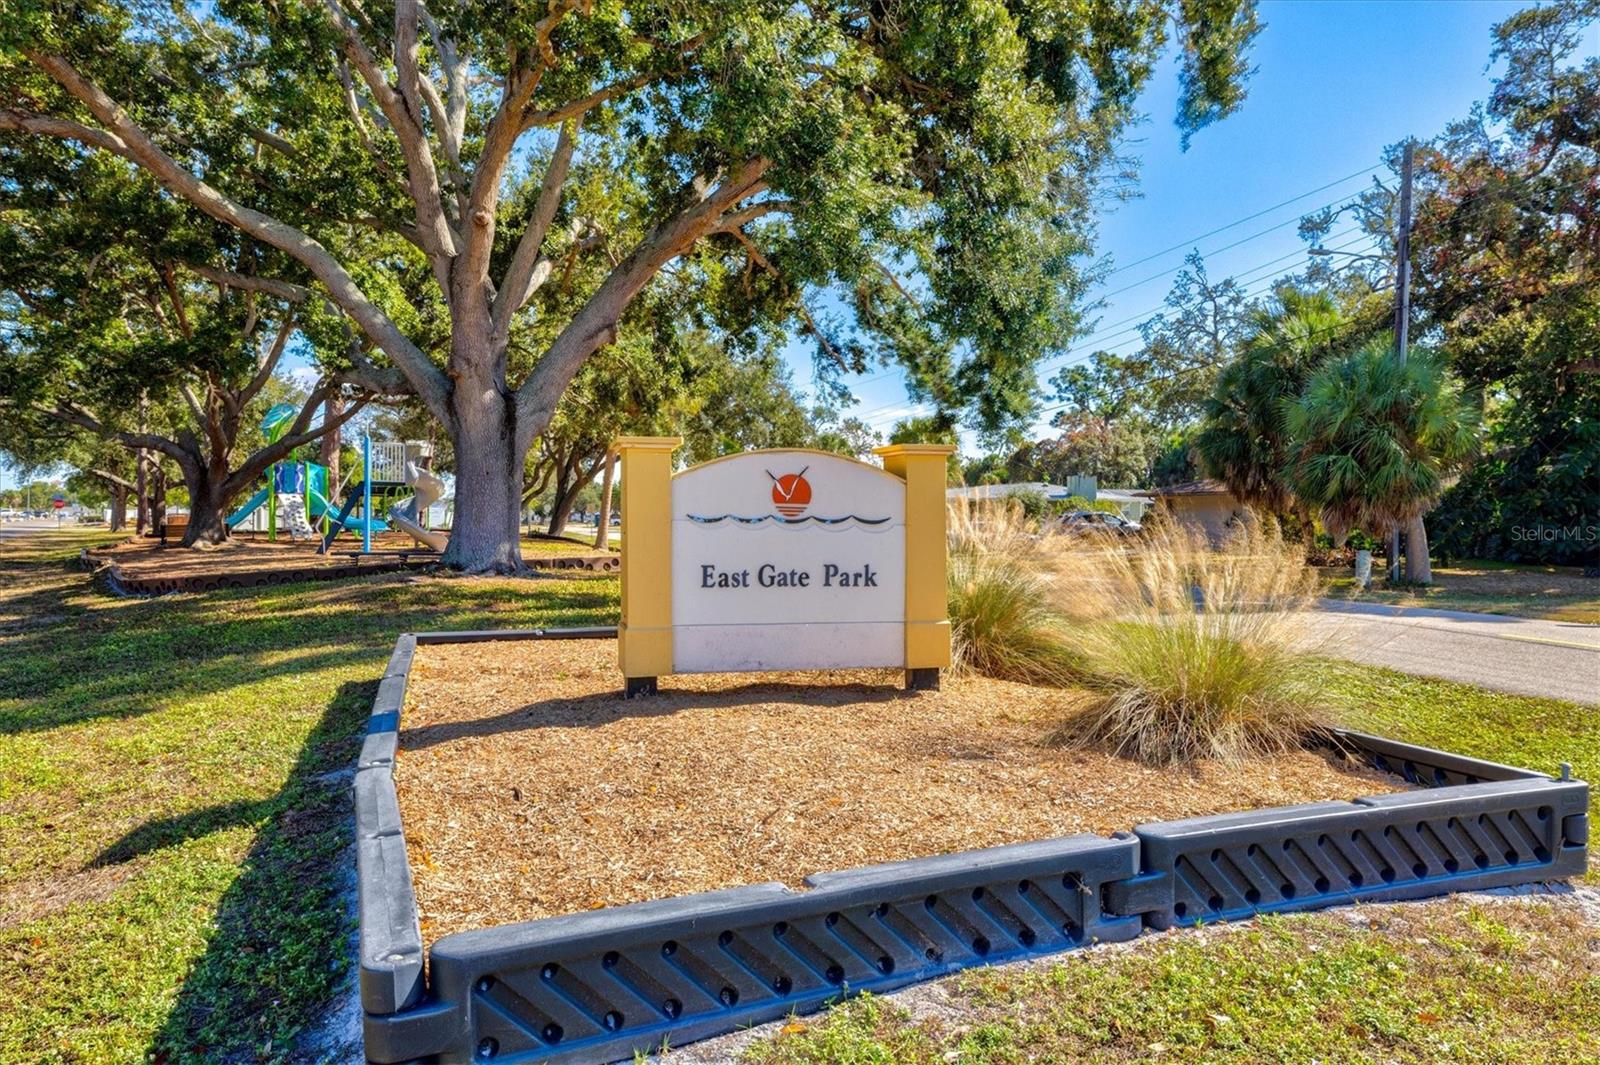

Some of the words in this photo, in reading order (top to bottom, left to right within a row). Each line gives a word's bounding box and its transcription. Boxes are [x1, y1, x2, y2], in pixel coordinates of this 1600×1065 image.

[700, 564, 750, 588] East
[757, 563, 810, 588] Gate
[823, 564, 878, 588] Park
